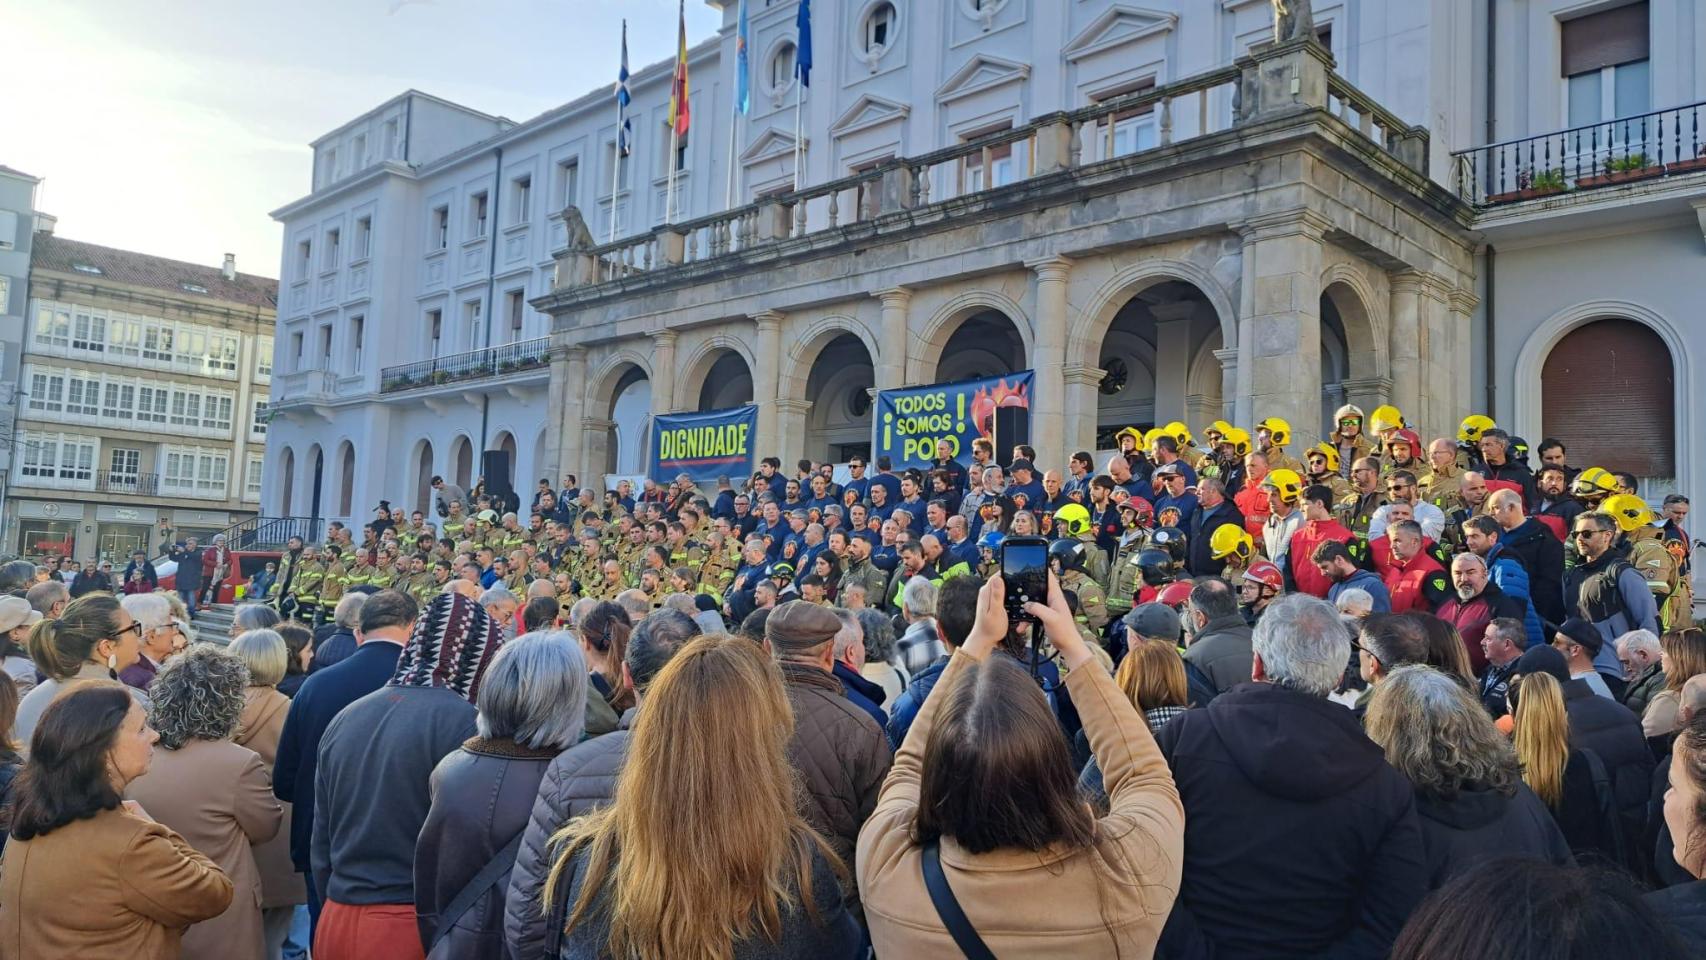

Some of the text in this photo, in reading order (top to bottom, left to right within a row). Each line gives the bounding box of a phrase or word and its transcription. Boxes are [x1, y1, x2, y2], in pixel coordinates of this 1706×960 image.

[894, 392, 946, 415] TODOS
[896, 413, 952, 435] SOMOS
[660, 423, 748, 460] DIGNIDADE
